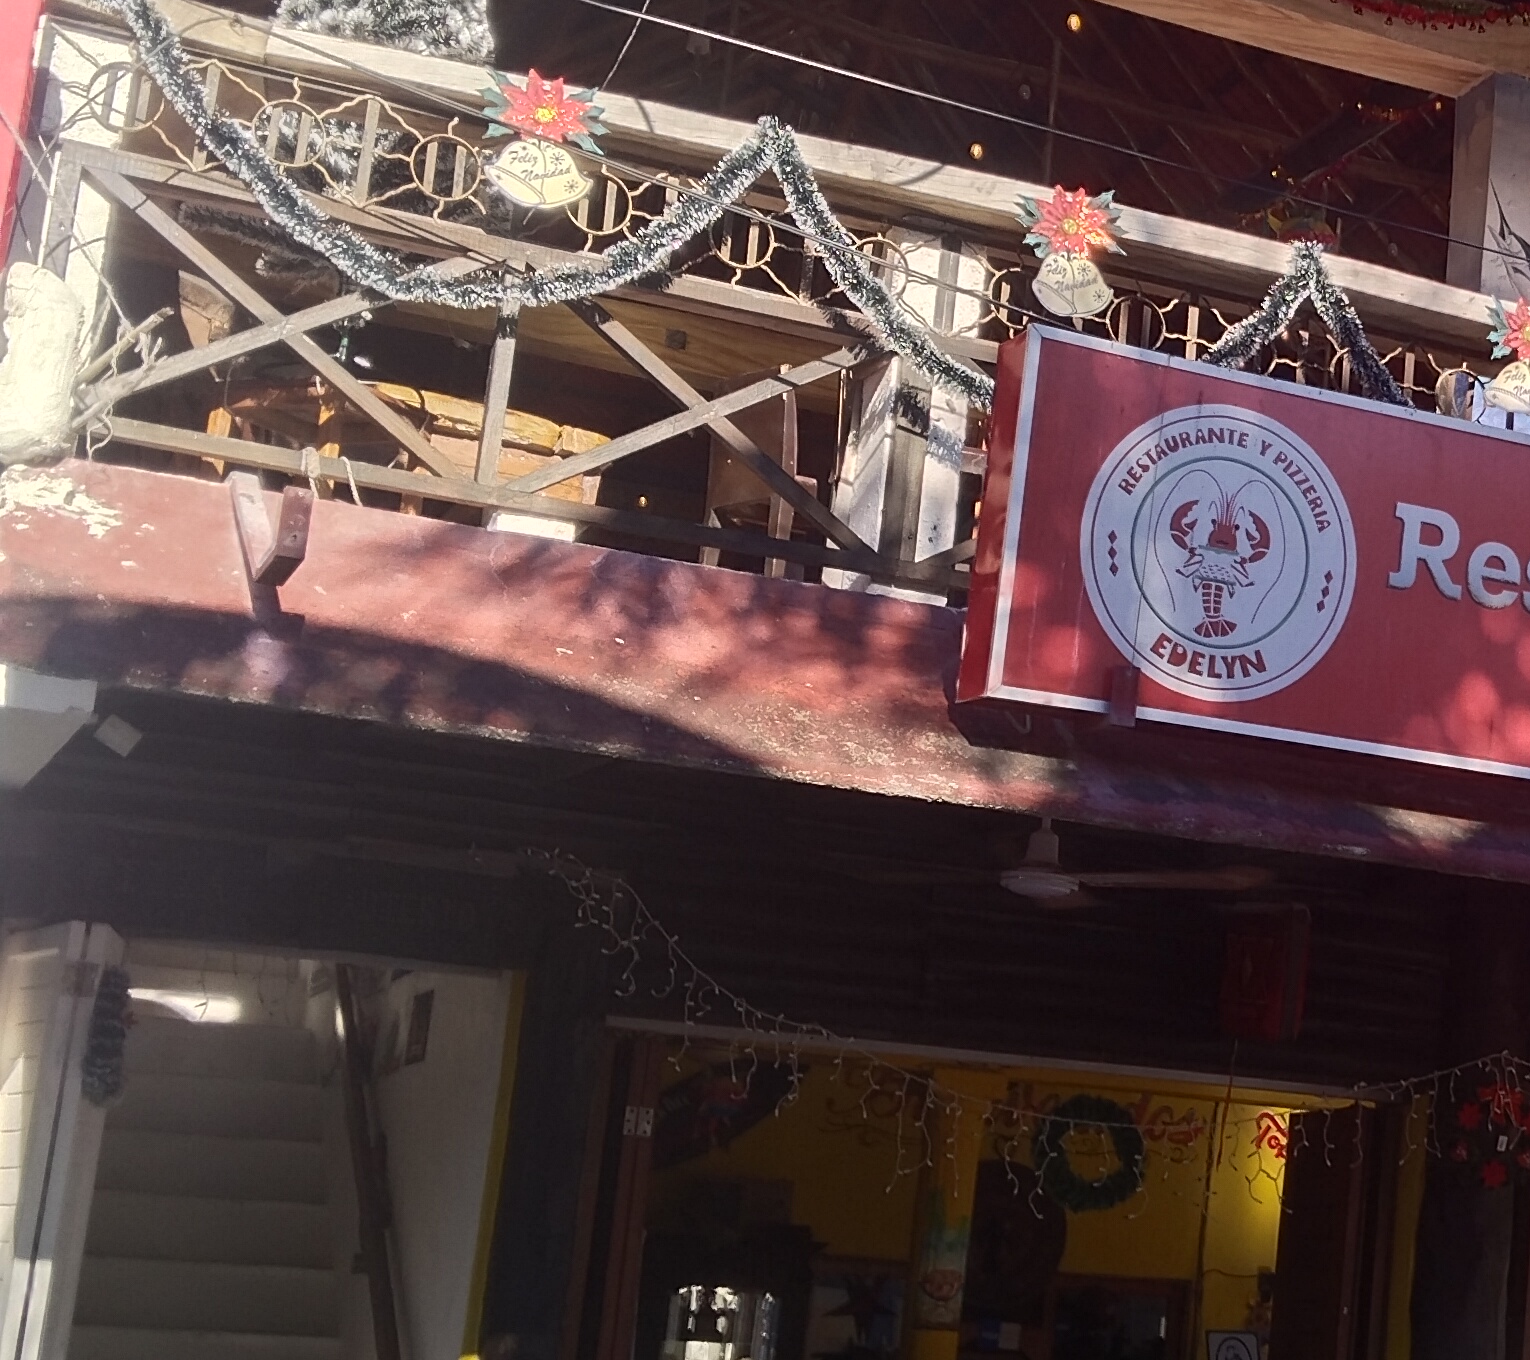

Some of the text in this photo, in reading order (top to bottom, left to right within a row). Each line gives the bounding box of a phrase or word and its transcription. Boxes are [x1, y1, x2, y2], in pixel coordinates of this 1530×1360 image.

[1118, 426, 1331, 534] RESTAURANTE Y PIZZERIA
[1150, 632, 1267, 679] EDELYN
